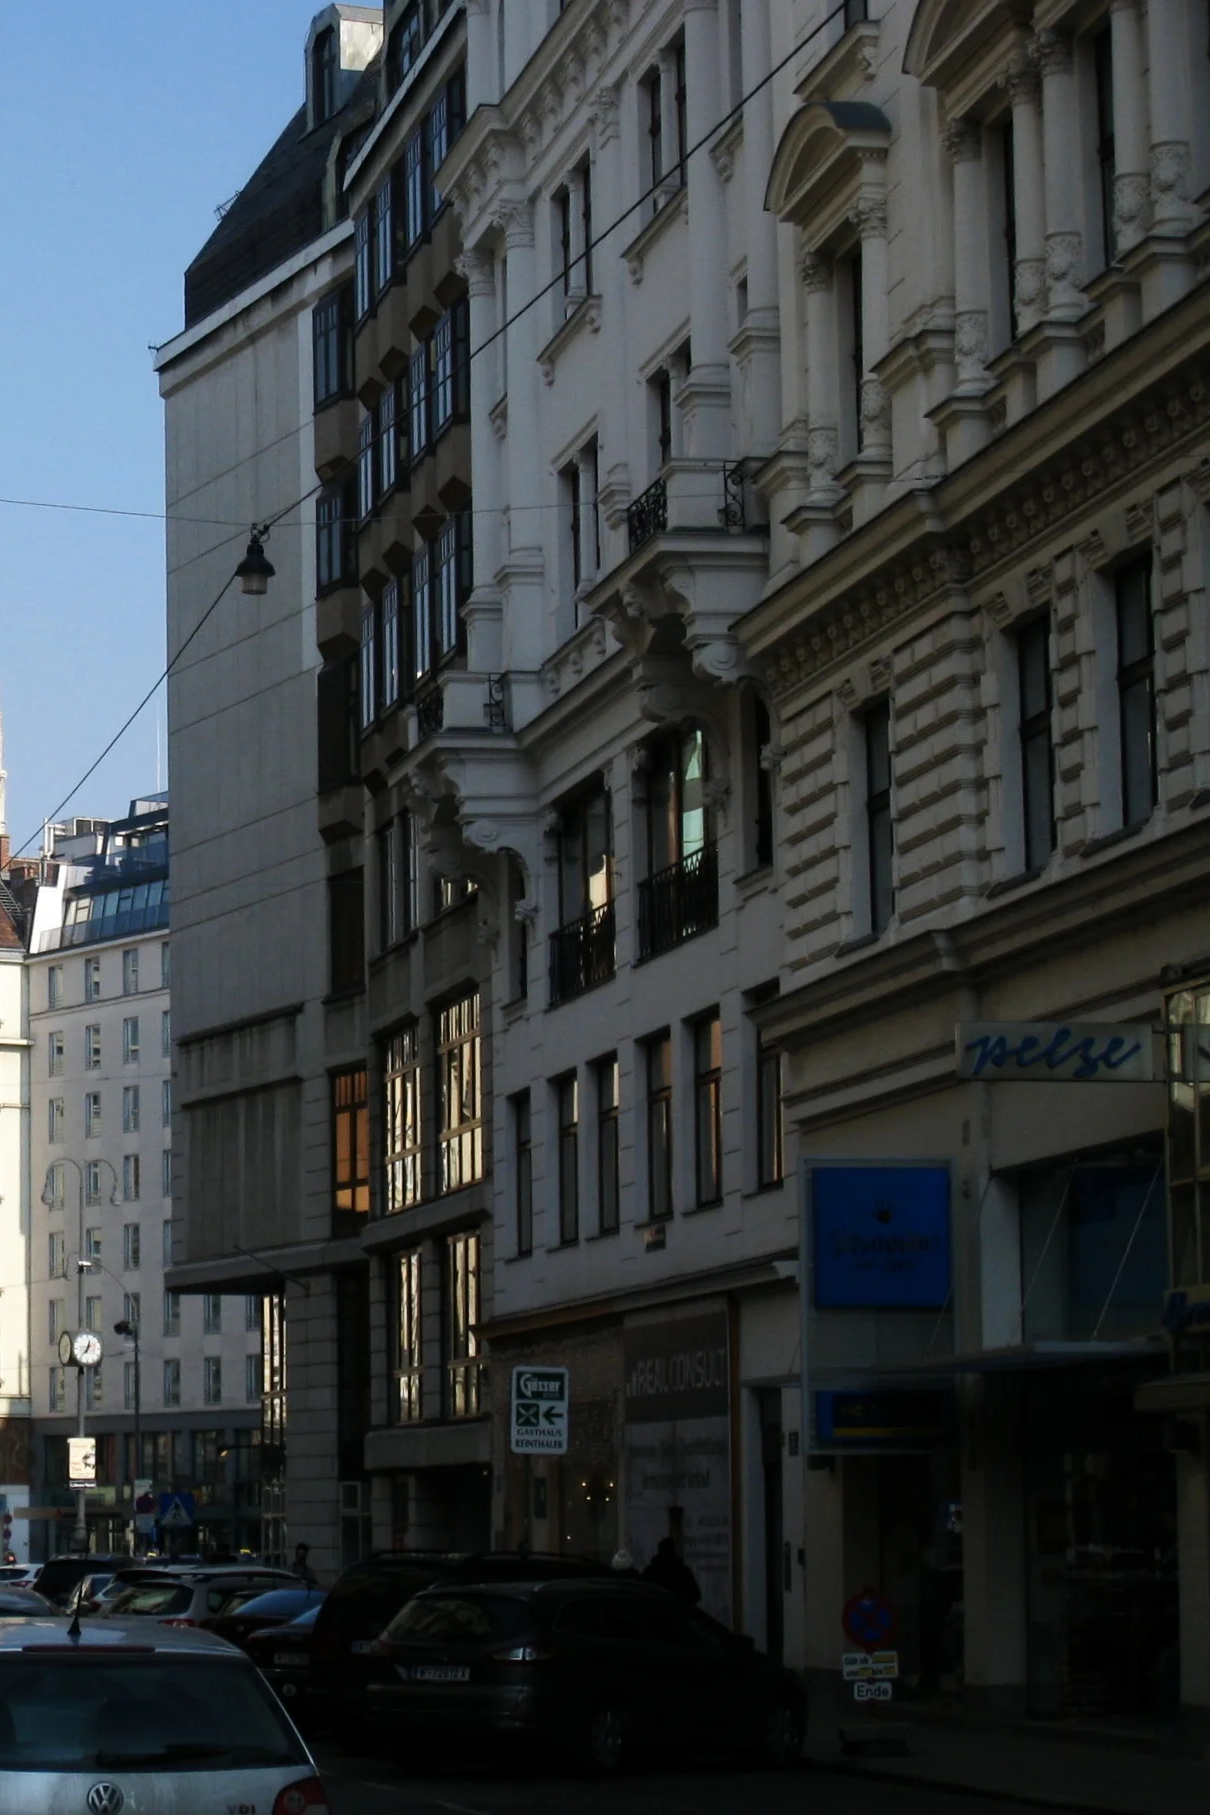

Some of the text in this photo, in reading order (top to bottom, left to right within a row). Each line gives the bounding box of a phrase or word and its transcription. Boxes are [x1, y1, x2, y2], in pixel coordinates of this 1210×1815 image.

[965, 1027, 1141, 1078] pelze
[669, 1348, 727, 1393] CONSULT
[519, 1373, 562, 1399] Gösser
[516, 1427, 563, 1438] GASTHAUS
[515, 1438, 563, 1449] REINTHALER
[856, 1684, 890, 1698] Ende
